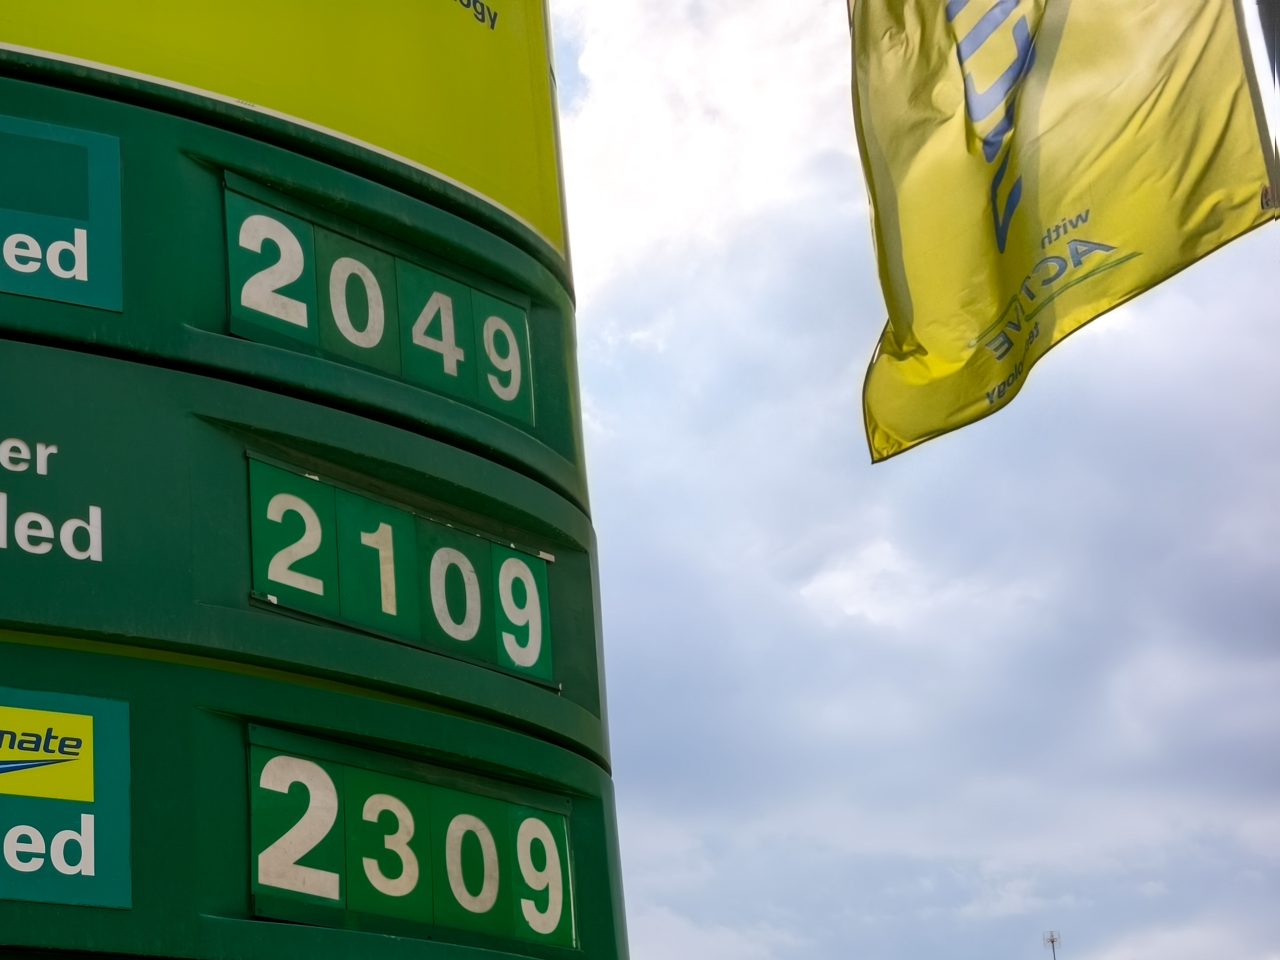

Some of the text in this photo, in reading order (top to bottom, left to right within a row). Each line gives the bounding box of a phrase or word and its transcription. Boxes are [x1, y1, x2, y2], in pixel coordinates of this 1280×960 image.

[238, 214, 522, 401] 2049
[266, 492, 544, 669] 2109
[257, 754, 564, 935] 2309
